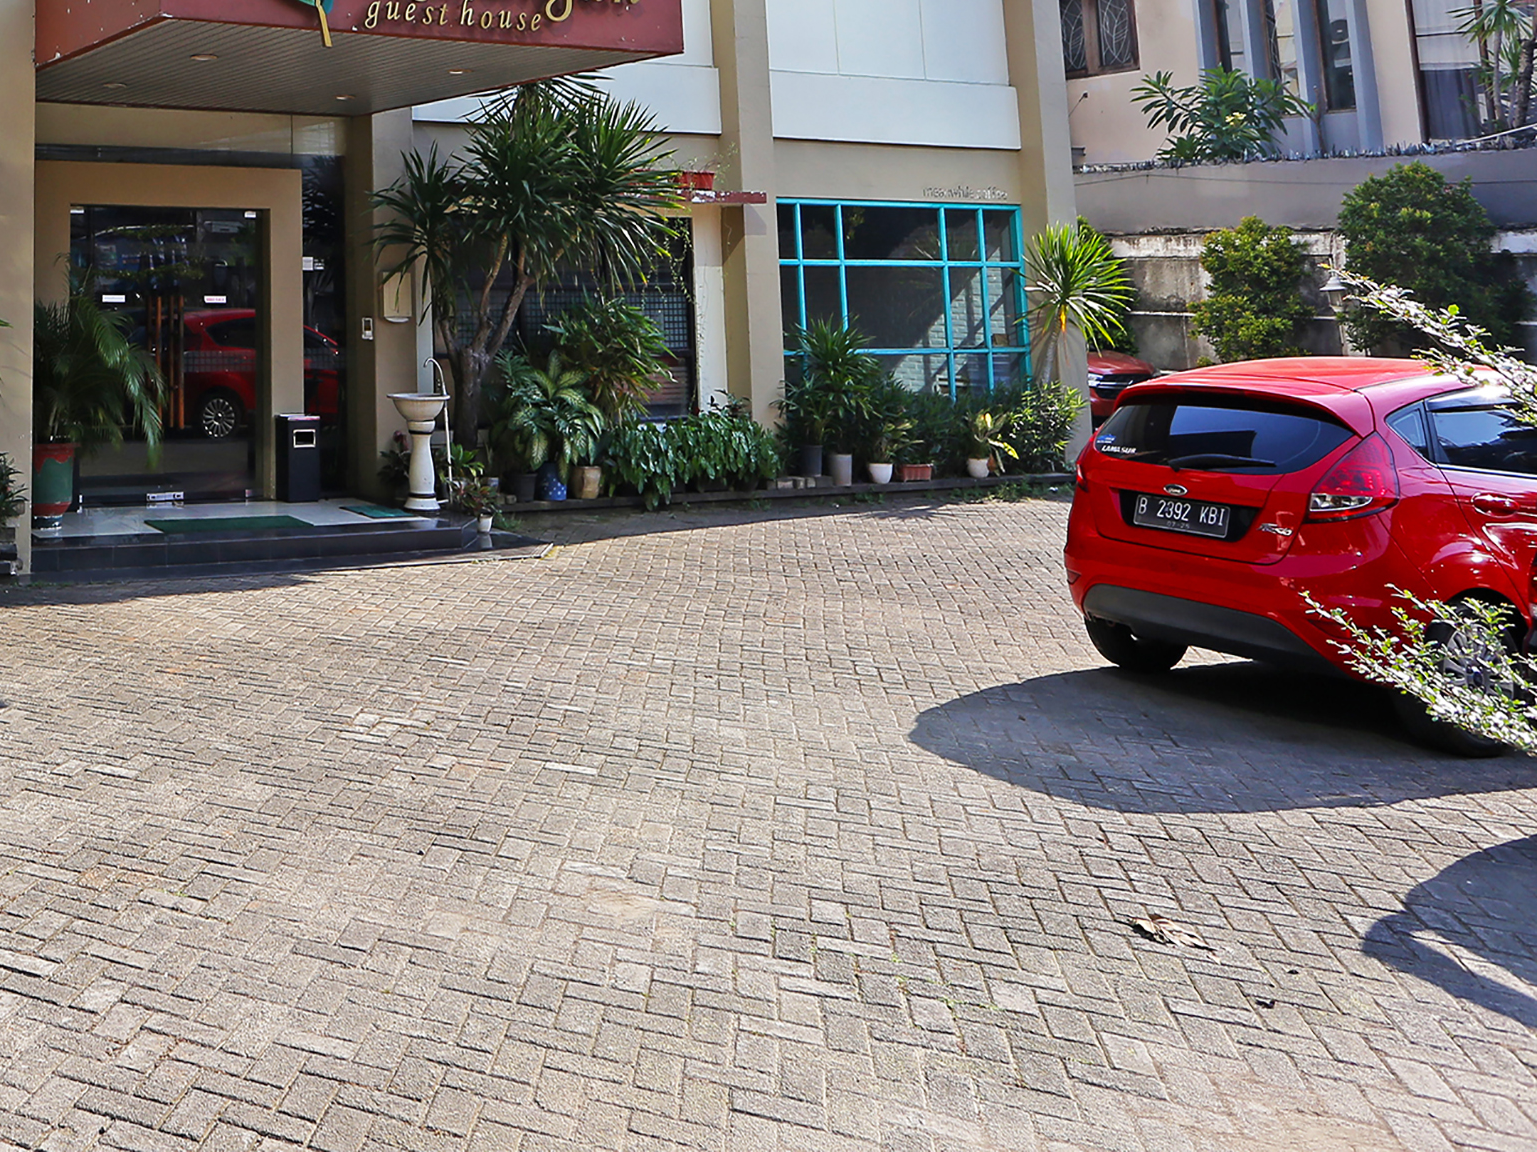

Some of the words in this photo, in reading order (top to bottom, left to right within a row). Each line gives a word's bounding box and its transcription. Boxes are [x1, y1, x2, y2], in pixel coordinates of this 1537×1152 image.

[364, 0, 448, 29] guest
[1138, 497, 1148, 514] B
[1156, 500, 1191, 522] 2392
[1199, 506, 1225, 526] KBI
